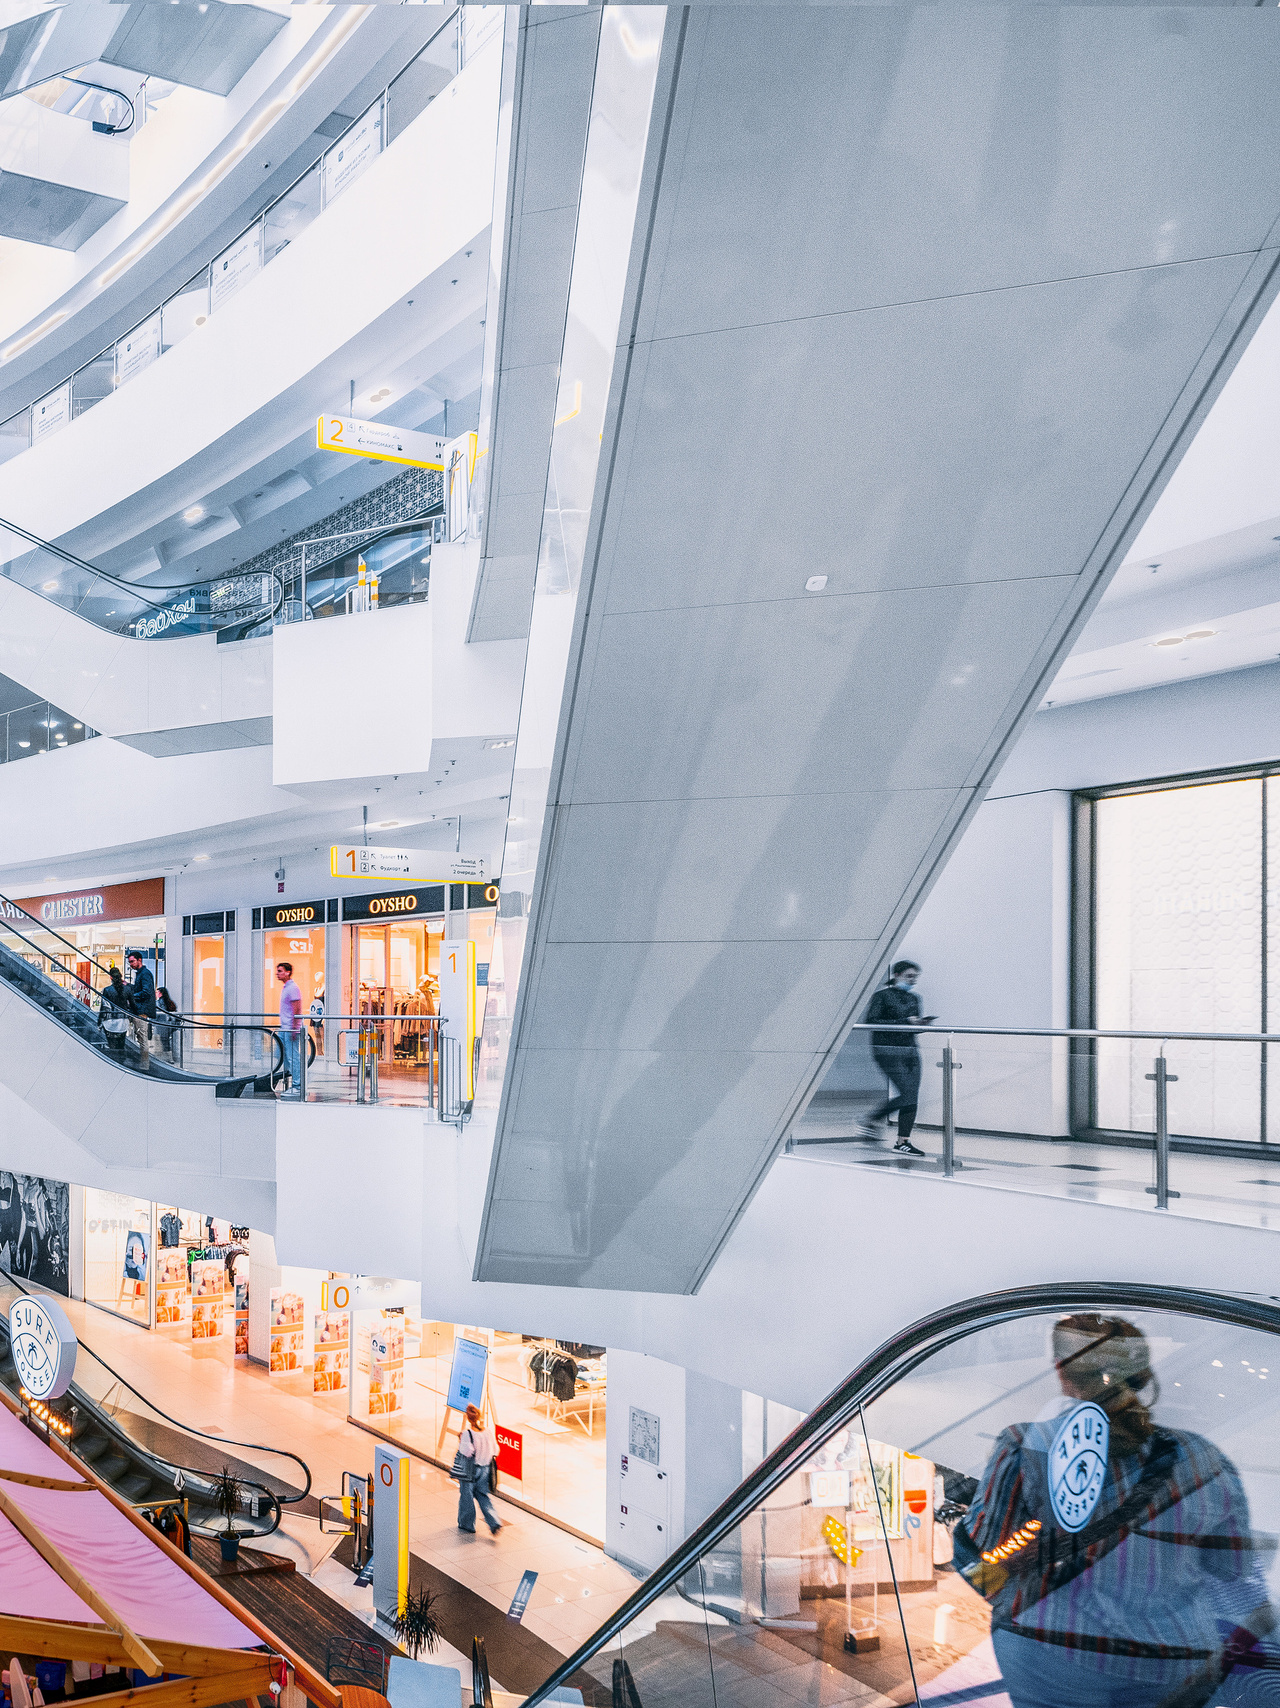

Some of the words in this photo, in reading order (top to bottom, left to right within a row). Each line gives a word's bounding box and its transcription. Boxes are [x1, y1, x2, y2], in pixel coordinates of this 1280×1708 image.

[330, 419, 343, 443] 2
[346, 850, 356, 872] 1
[41, 895, 103, 920] CHESTER
[369, 895, 417, 913] OYSHO
[276, 907, 314, 923] OYSHO
[448, 953, 456, 973] 1
[88, 1218, 132, 1231] O'STIN
[15, 1308, 53, 1345] SURF
[16, 1348, 50, 1387] COFFEE
[497, 1433, 520, 1451] SALE
